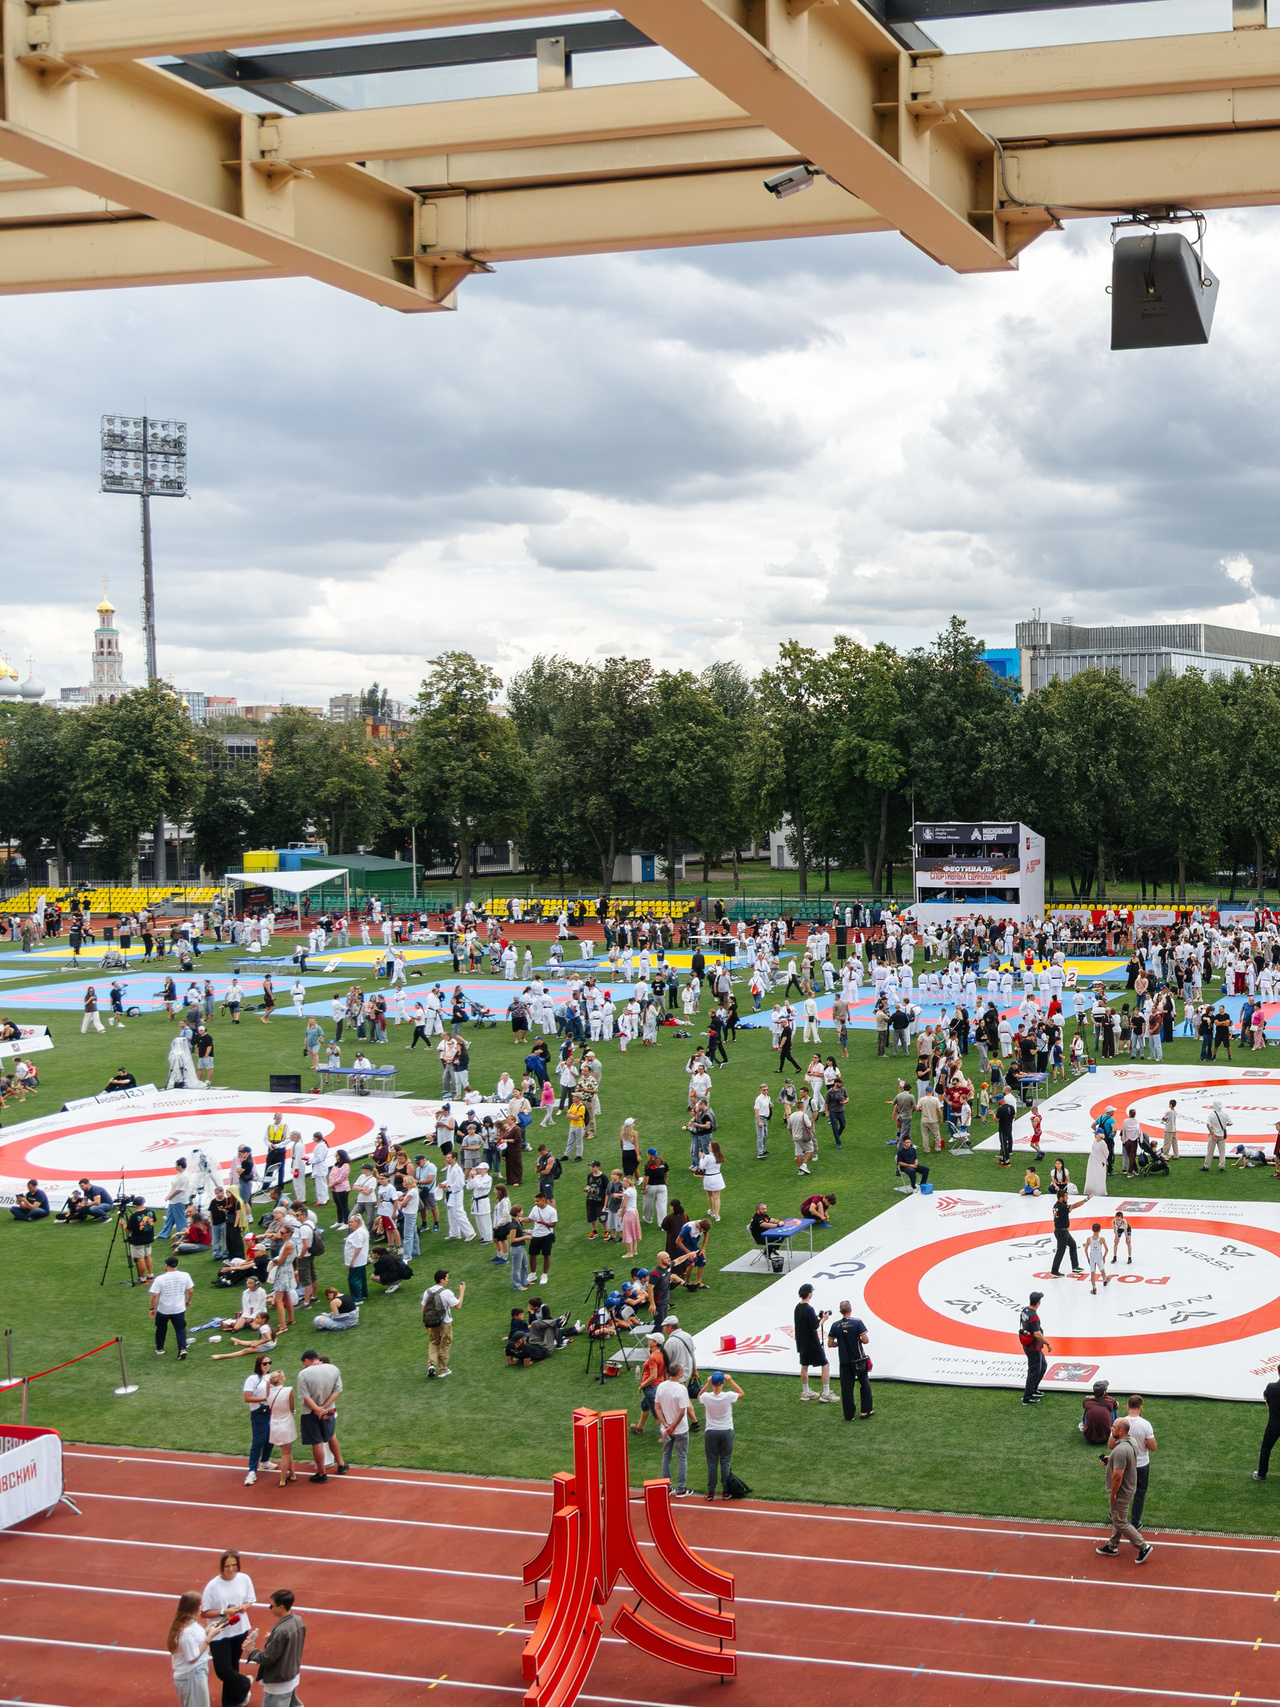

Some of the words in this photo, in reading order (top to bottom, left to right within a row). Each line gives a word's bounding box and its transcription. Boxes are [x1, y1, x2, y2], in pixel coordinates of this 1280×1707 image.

[982, 826, 1013, 835] МОСКОВСКИЙ
[930, 872, 966, 880] СПОРТИВНЫХ
[968, 872, 1006, 881] ЕДИНОБОРСТВ
[1068, 972, 1076, 981] 2
[1164, 1202, 1238, 1210] Департамент
[1173, 1246, 1235, 1271] AVEASA
[1118, 1294, 1213, 1318] AVEASA
